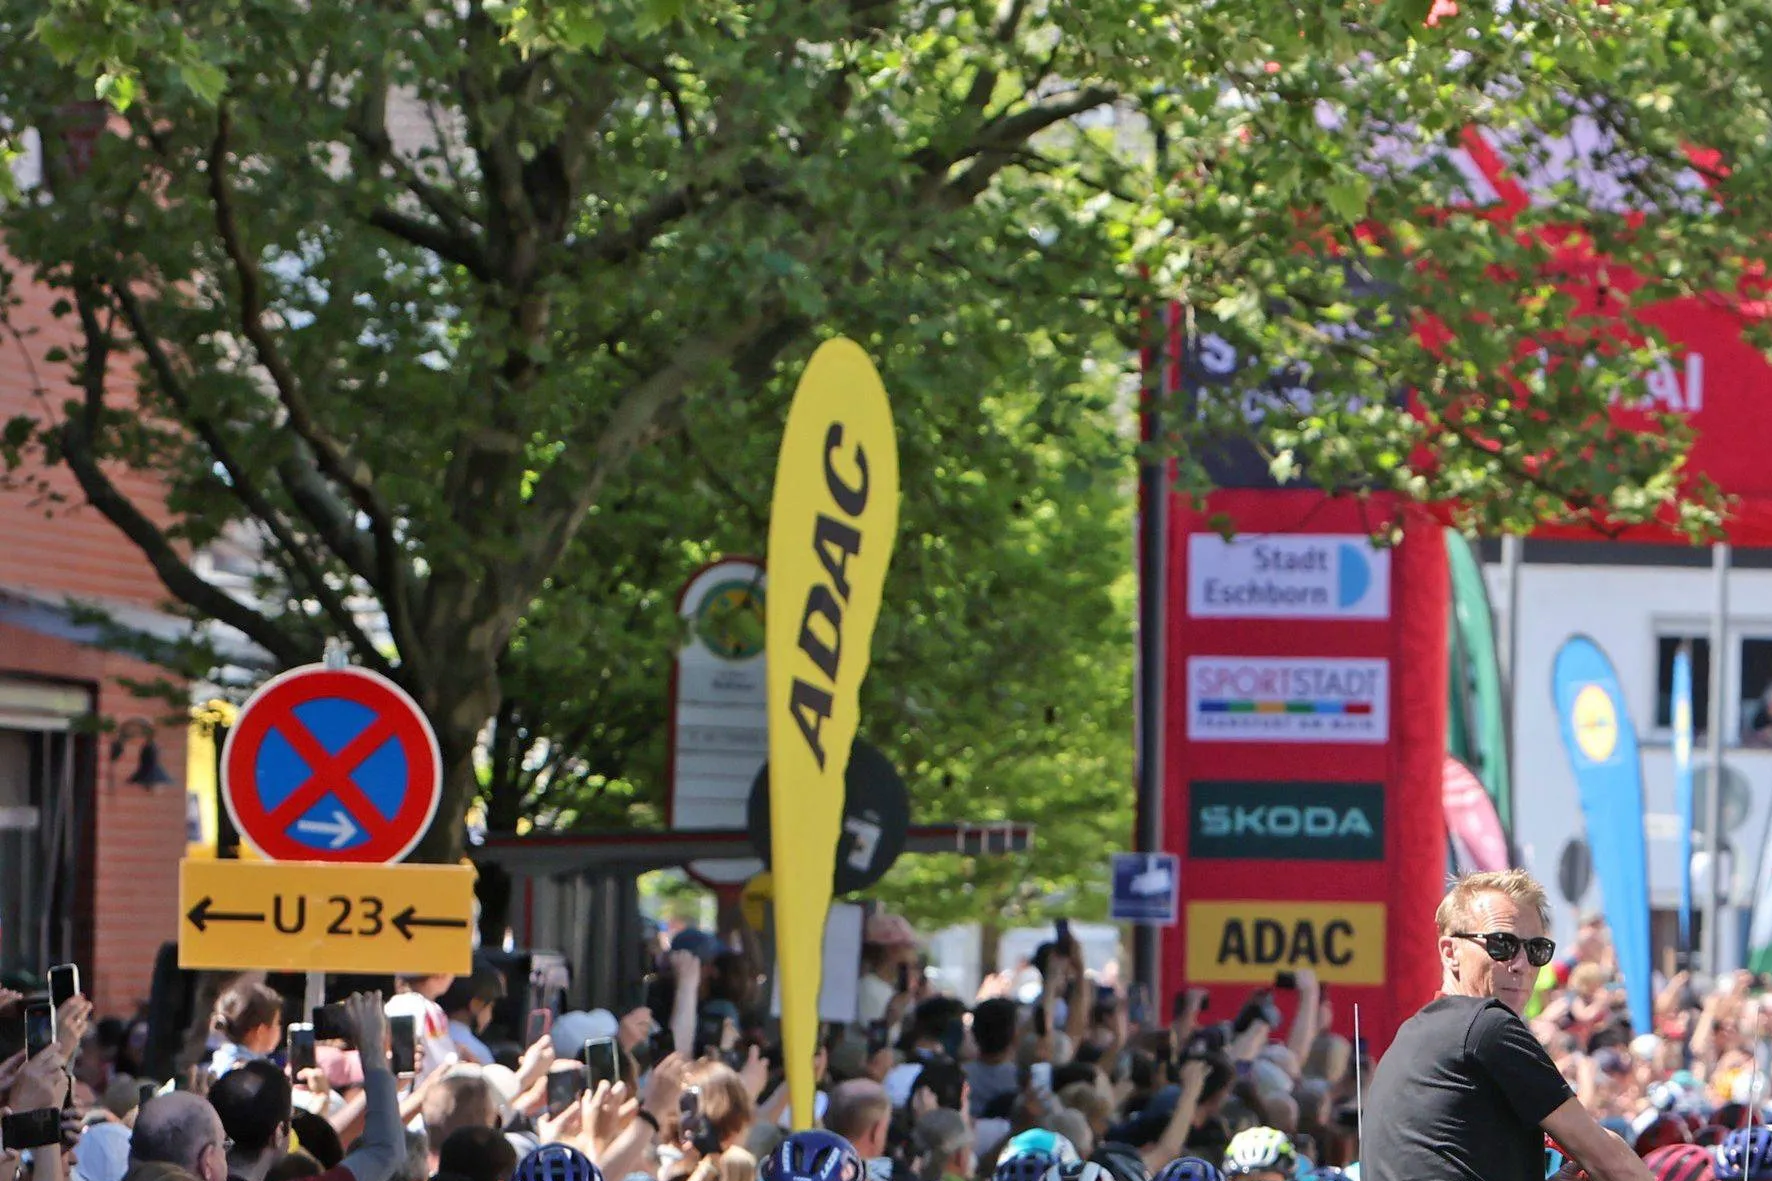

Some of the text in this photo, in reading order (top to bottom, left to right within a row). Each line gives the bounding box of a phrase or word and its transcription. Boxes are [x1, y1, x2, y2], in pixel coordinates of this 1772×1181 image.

[1253, 547, 1329, 572] Stadt
[789, 421, 870, 775] ADAC
[1203, 577, 1329, 604] Eschborn
[273, 894, 384, 937] U 23
[1216, 917, 1355, 965] ADAC
